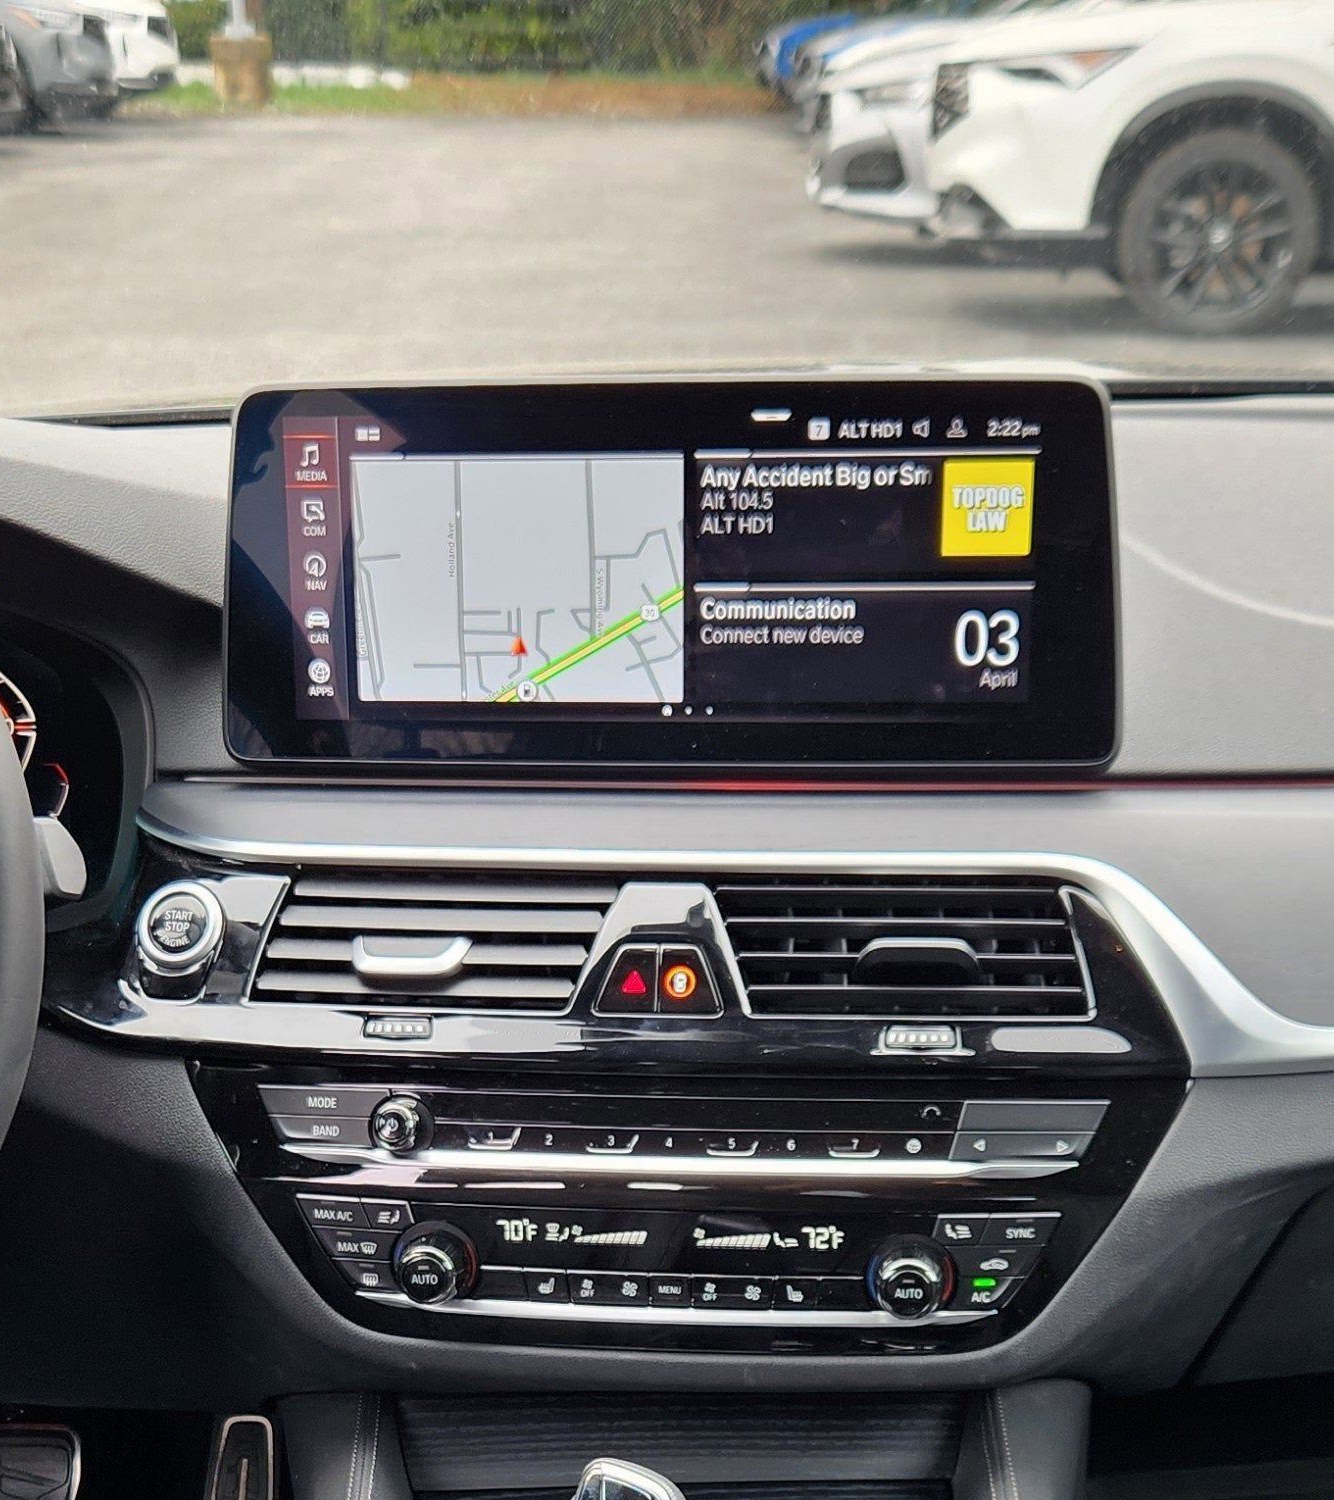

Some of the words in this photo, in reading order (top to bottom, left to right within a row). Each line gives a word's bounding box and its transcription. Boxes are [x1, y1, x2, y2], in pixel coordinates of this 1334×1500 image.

[838, 420, 866, 438] ALT
[871, 419, 903, 438] HD1
[295, 470, 327, 482] MEDIA
[700, 465, 741, 490] Any
[742, 463, 832, 488] Accident
[836, 462, 871, 490] Big
[873, 467, 895, 486] or
[700, 491, 727, 511] Alt
[729, 490, 774, 510] 104.5
[952, 487, 1025, 509] TOPDOG
[700, 516, 735, 535] ALT
[738, 515, 774, 534] HD1
[967, 510, 1008, 533] LAW
[302, 526, 326, 537] COM
[448, 541, 456, 578] Holland
[306, 580, 327, 591] NAV
[700, 597, 856, 622] Communication
[310, 634, 329, 645] CAR
[700, 625, 770, 645] Connect
[772, 629, 807, 644] new
[809, 624, 864, 645] device
[954, 609, 1020, 667] 03
[979, 668, 1018, 690] April
[308, 686, 334, 697] APPS
[164, 910, 194, 921] START
[165, 921, 190, 932] STOP
[308, 1096, 338, 1109] MODE
[312, 1125, 340, 1137] BAND
[545, 1134, 553, 1146] 2
[607, 1135, 615, 1147] 3
[665, 1137, 673, 1148] 4
[728, 1138, 736, 1149] 5
[787, 1139, 796, 1151] 6
[852, 1138, 860, 1150] 7
[314, 1208, 335, 1221] MAX
[337, 1210, 354, 1223] A/C
[1005, 1227, 1036, 1240] SYNC
[337, 1241, 359, 1254] MAX
[410, 1273, 439, 1286] AUTO
[580, 1289, 595, 1298] OFF
[658, 1285, 682, 1295] MENU
[894, 1287, 924, 1300] AUTO
[702, 1293, 718, 1301] OFF
[971, 1291, 991, 1304] A/C
